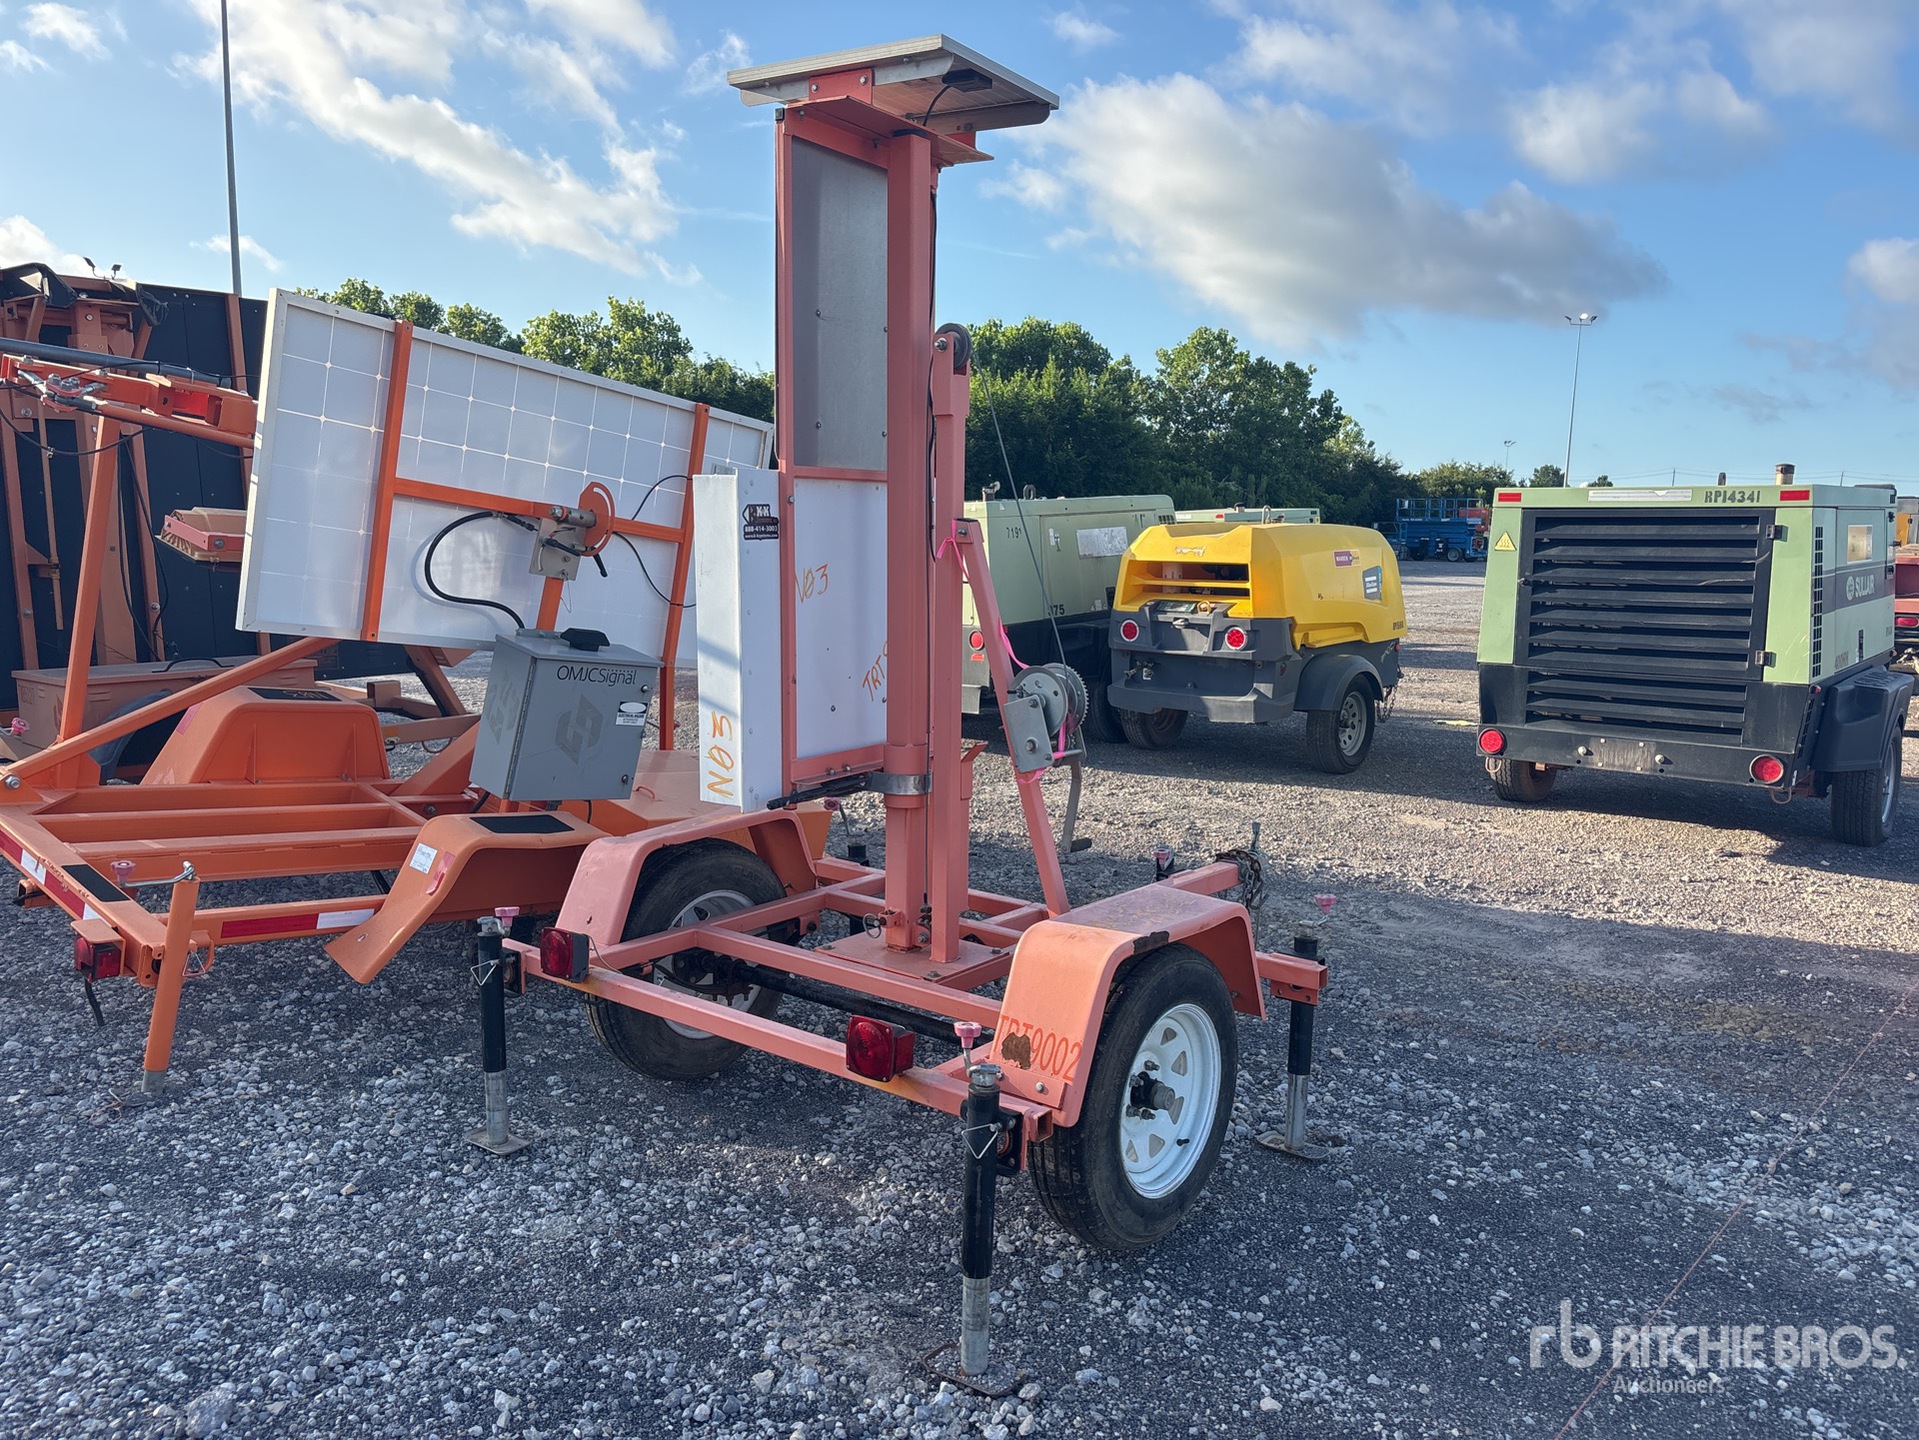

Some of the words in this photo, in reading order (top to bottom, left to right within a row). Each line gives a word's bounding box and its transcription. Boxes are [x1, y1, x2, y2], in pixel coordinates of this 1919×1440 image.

[744, 525, 778, 533] 888-414-3003
[1855, 575, 1875, 598] SULLAIR
[557, 665, 637, 687] OMJCSignal
